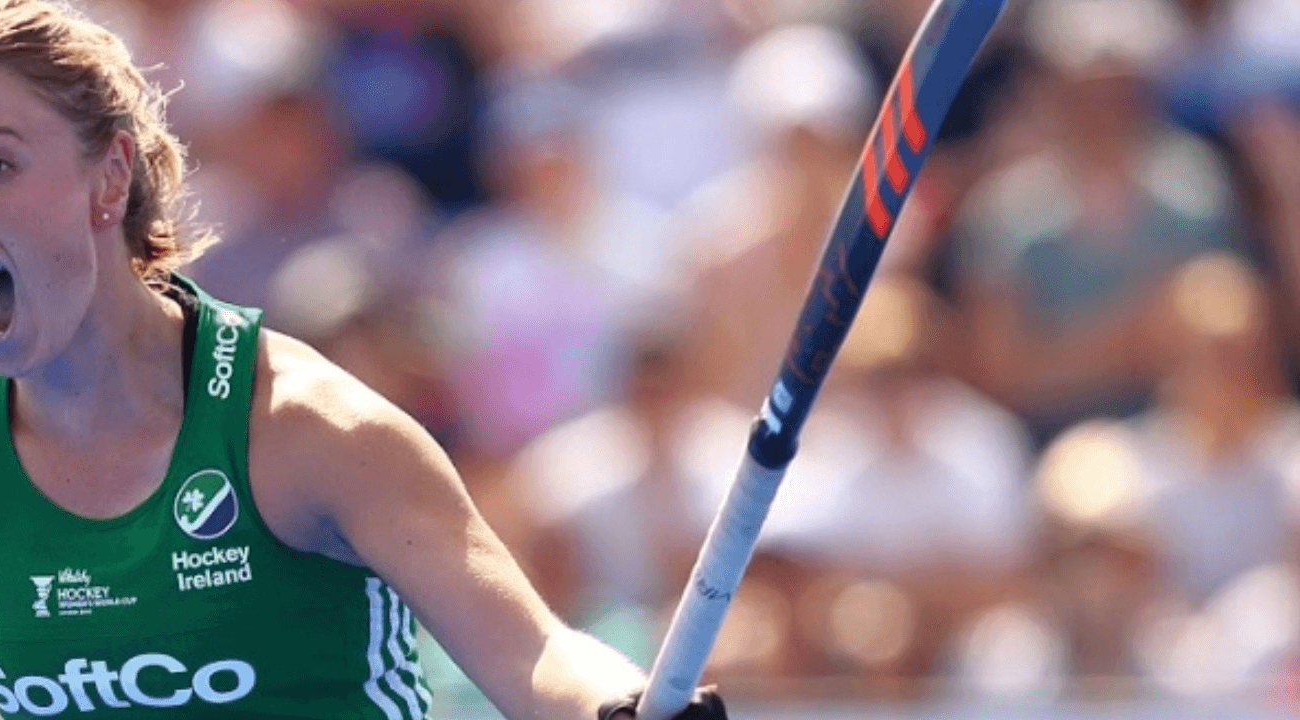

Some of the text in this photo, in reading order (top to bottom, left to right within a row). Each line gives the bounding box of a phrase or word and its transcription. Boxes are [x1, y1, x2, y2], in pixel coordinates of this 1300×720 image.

[171, 545, 251, 571] Hockey
[177, 562, 253, 592] Ireland
[57, 586, 110, 601] HOCKEY
